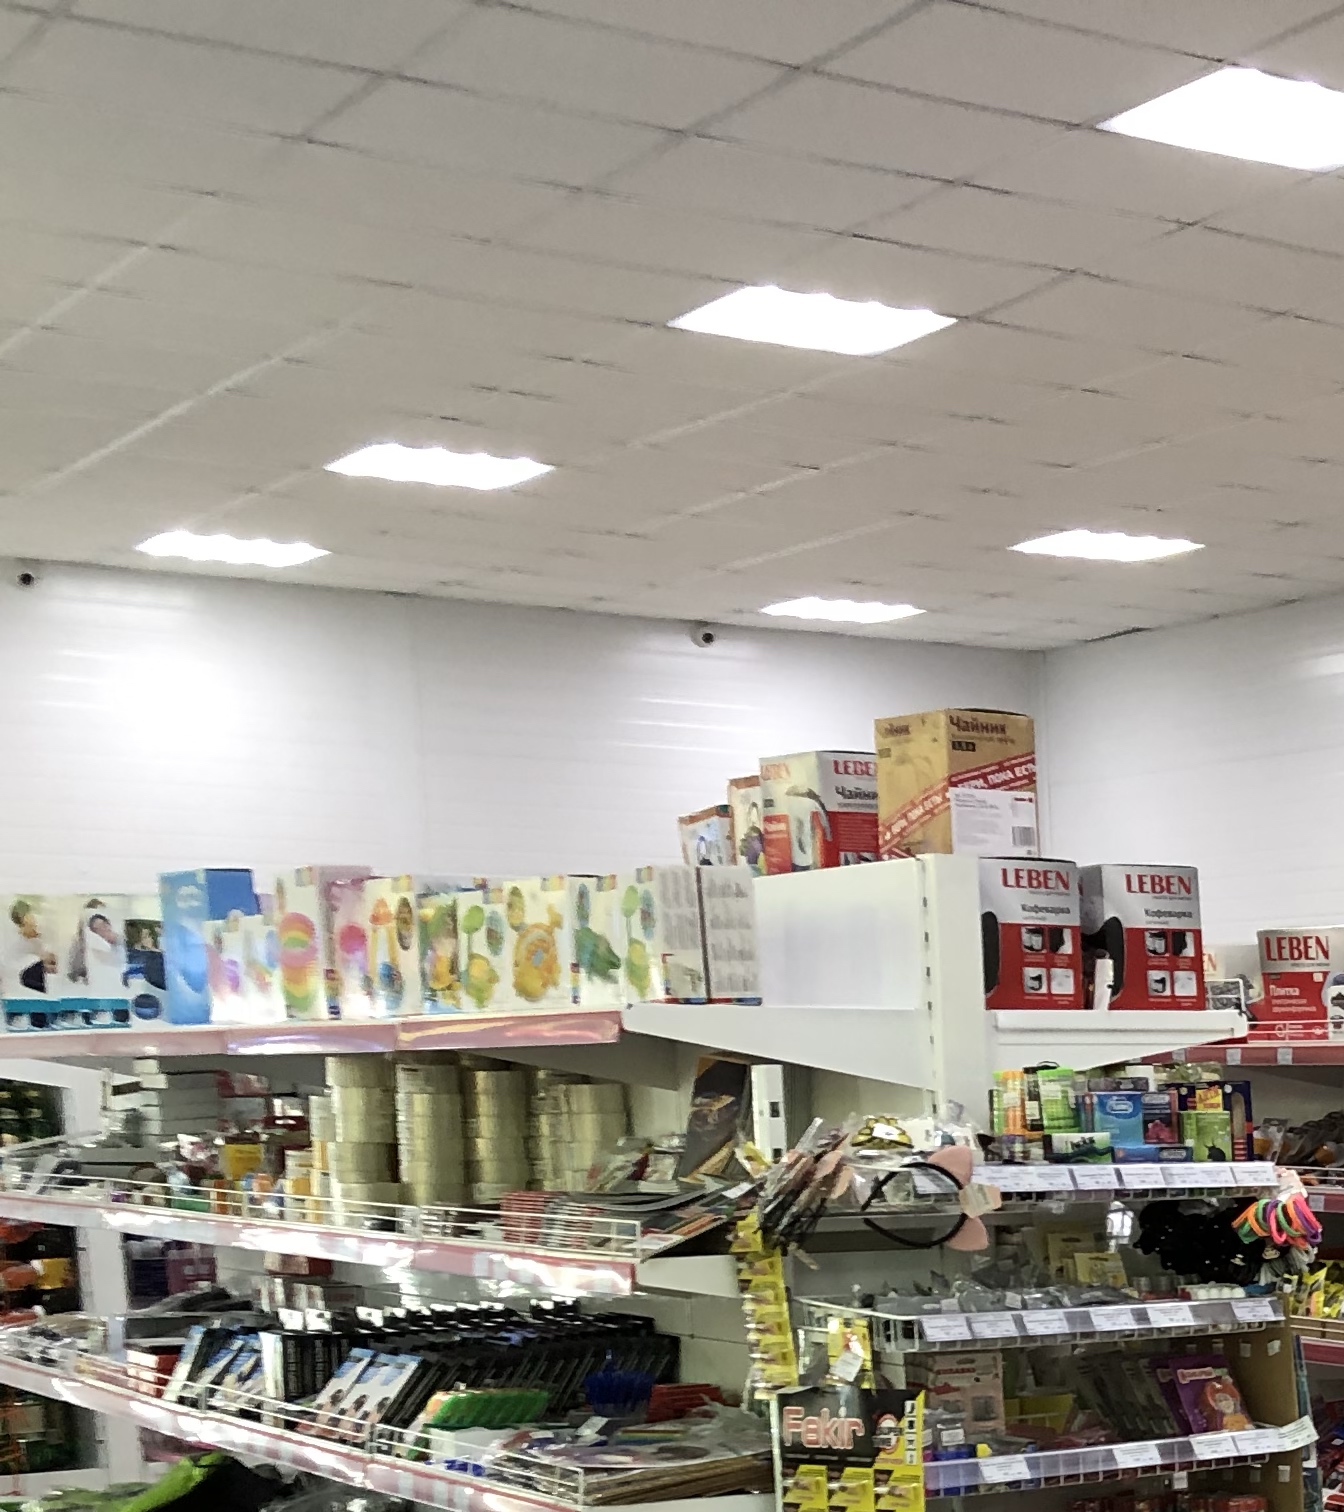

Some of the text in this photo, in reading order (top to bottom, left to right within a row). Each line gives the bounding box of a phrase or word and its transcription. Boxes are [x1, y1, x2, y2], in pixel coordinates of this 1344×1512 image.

[950, 715, 1007, 736] Чайник
[833, 759, 878, 776] LEBE
[1001, 867, 1070, 891] LEBEN
[1125, 873, 1193, 895] LEBEN
[1264, 935, 1330, 962] LEBEN
